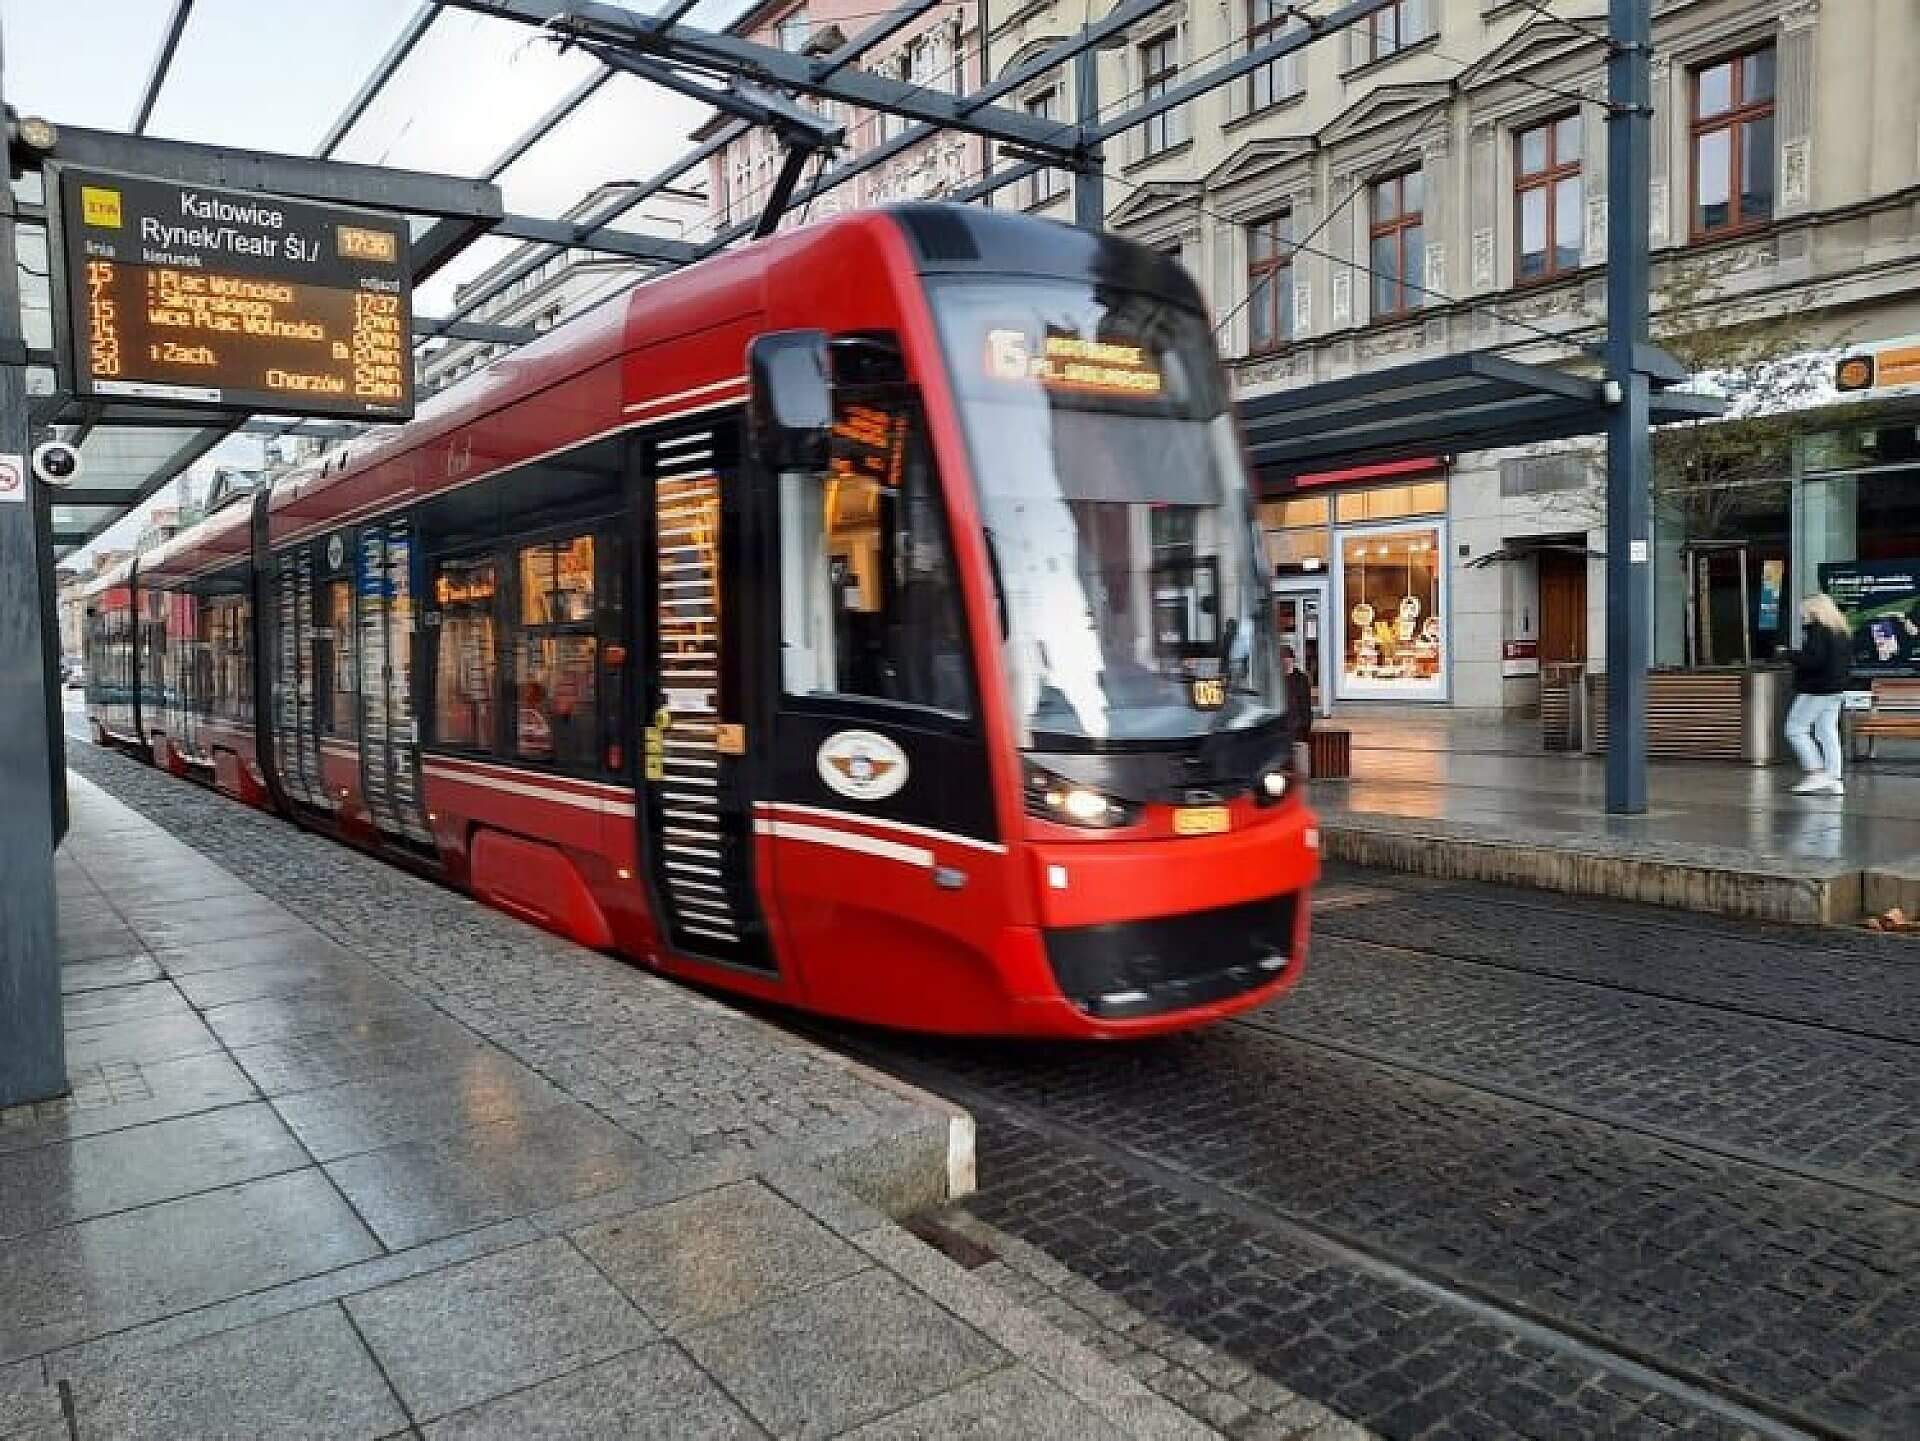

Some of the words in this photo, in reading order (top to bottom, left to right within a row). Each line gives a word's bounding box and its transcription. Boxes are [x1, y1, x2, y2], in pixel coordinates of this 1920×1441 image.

[181, 192, 284, 229] Katowice
[140, 216, 280, 257] Rynek/Teatr
[87, 263, 114, 282] 15
[89, 299, 114, 318] 15
